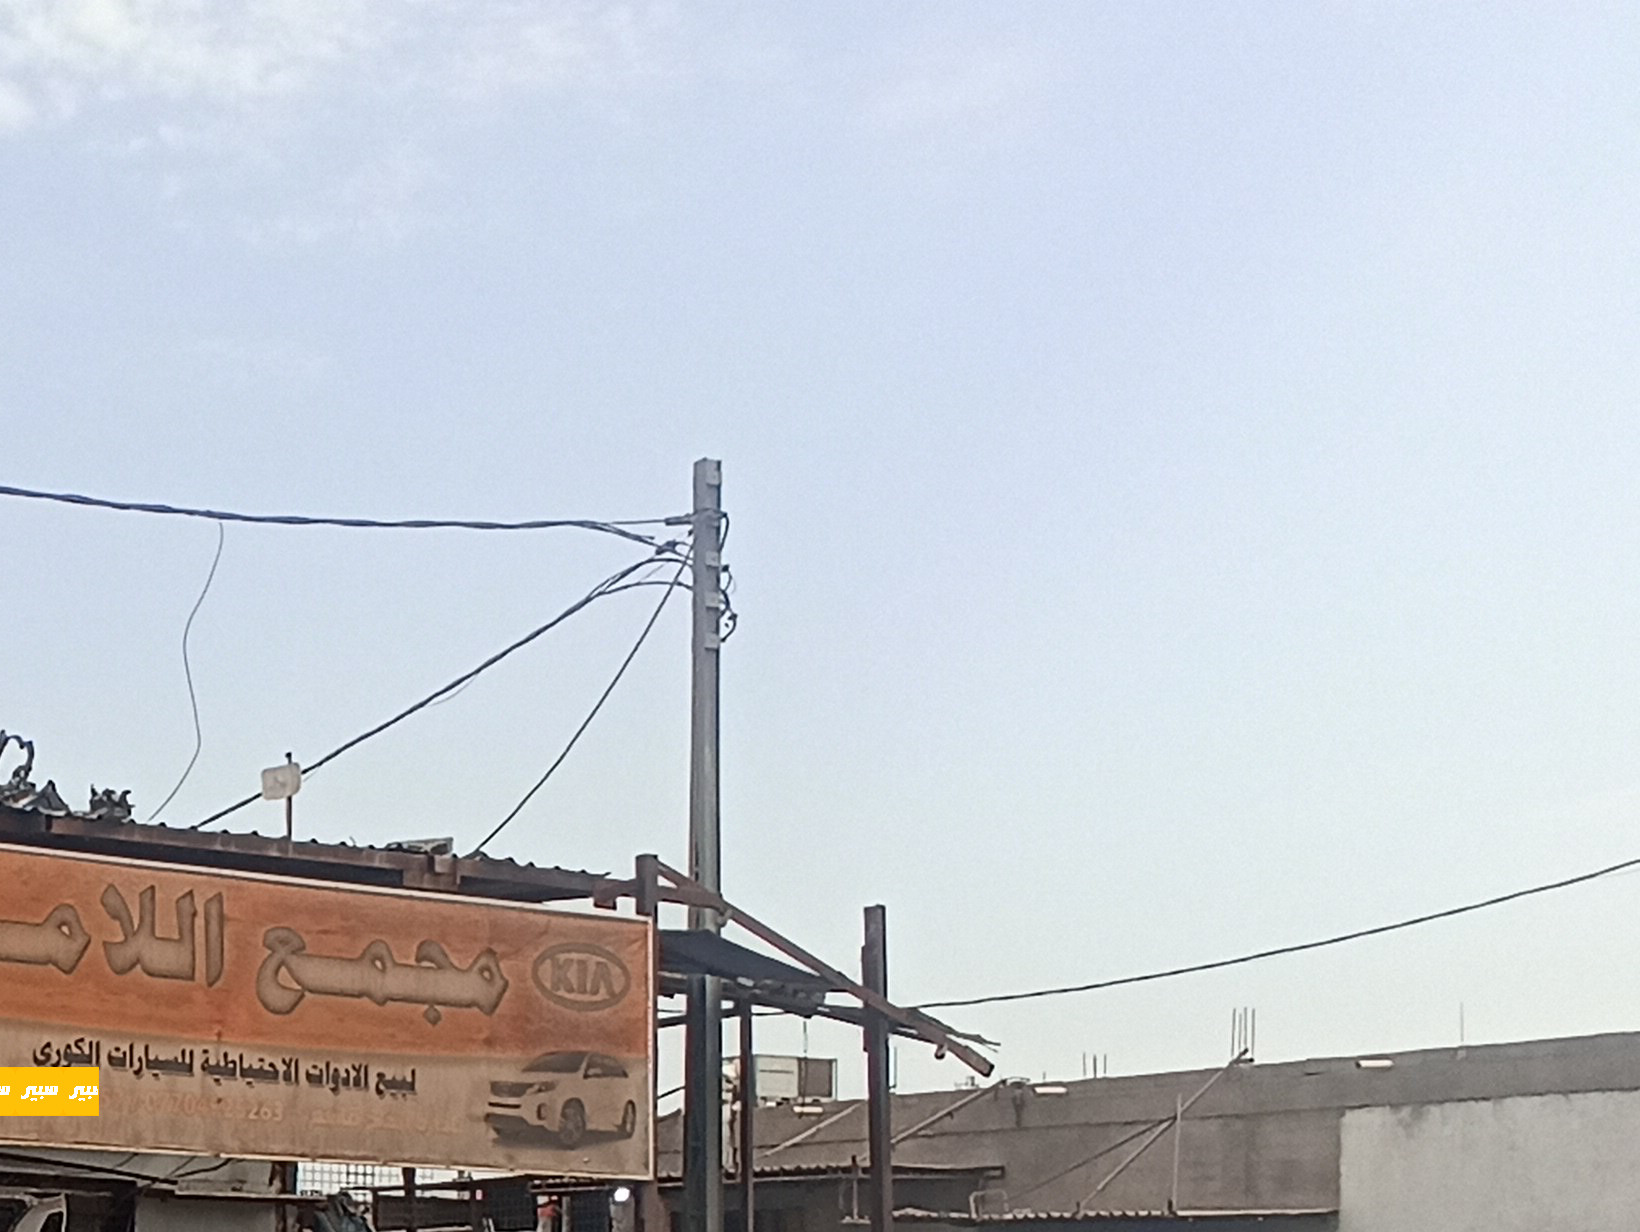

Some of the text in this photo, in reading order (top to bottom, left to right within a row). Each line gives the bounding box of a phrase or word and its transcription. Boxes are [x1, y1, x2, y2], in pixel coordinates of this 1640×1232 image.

[257, 926, 509, 1026] مجمع
[548, 956, 618, 999] KIA
[107, 1042, 195, 1079] للسيارات
[200, 1048, 300, 1088] الاحتياطية
[305, 1060, 369, 1095] الادوات
[375, 1068, 416, 1099] لبيع
